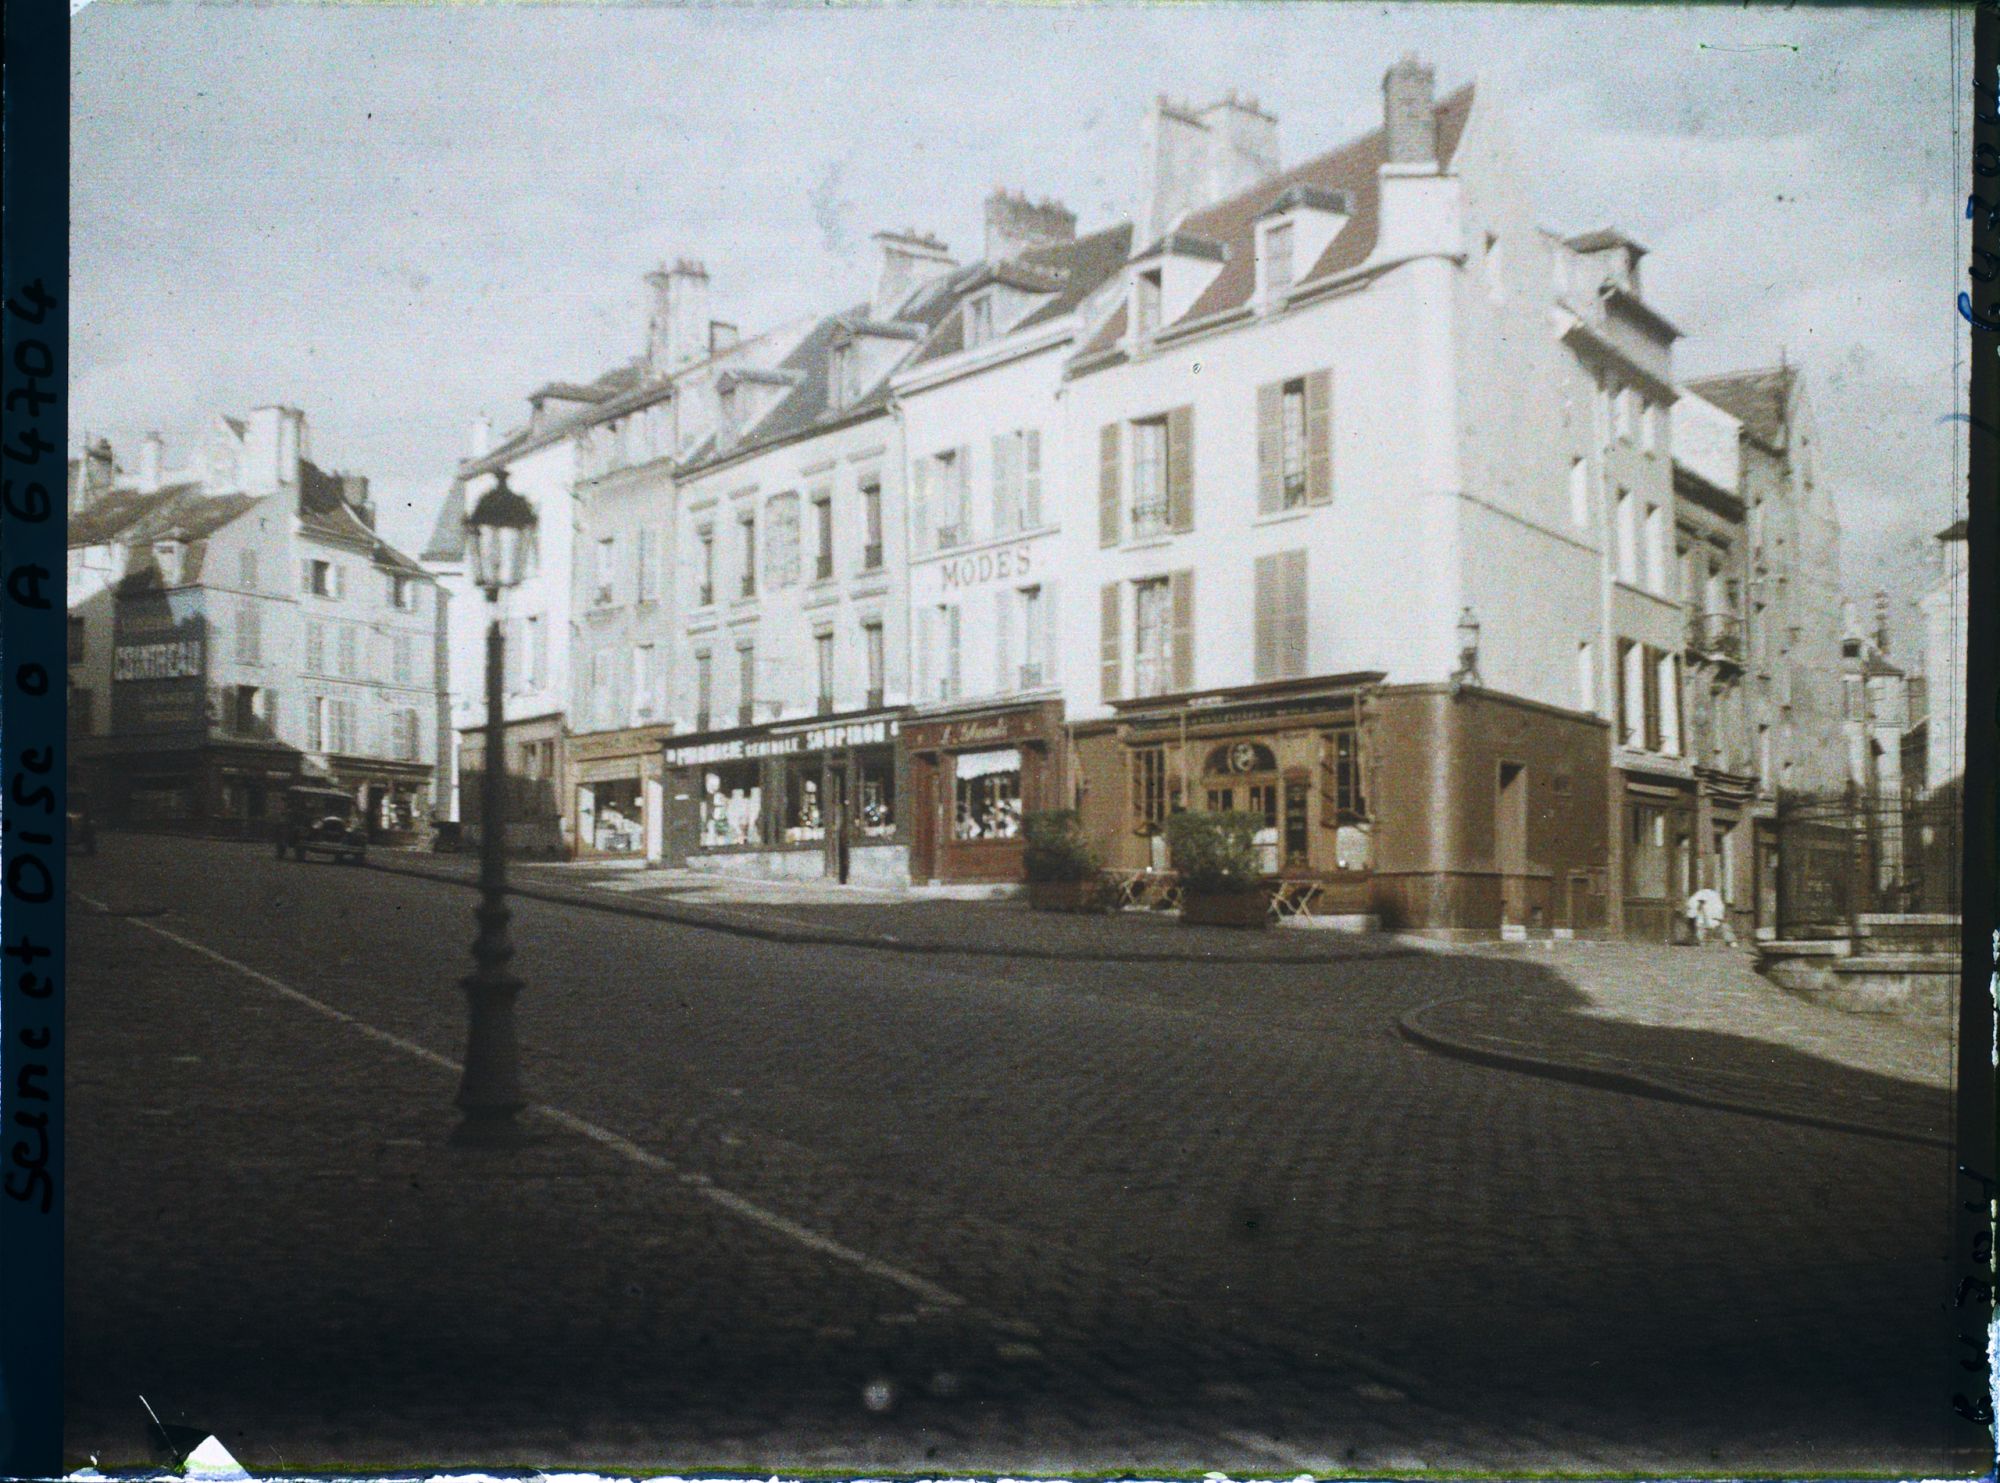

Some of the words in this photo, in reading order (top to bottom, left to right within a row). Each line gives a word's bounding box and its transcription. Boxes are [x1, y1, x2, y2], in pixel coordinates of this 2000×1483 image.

[2, 277, 57, 524] 64704
[7, 563, 52, 610] A
[942, 545, 1030, 590] MODES
[113, 641, 201, 681] COINTREAU
[2, 746, 55, 905] Oise
[5, 935, 51, 999] et
